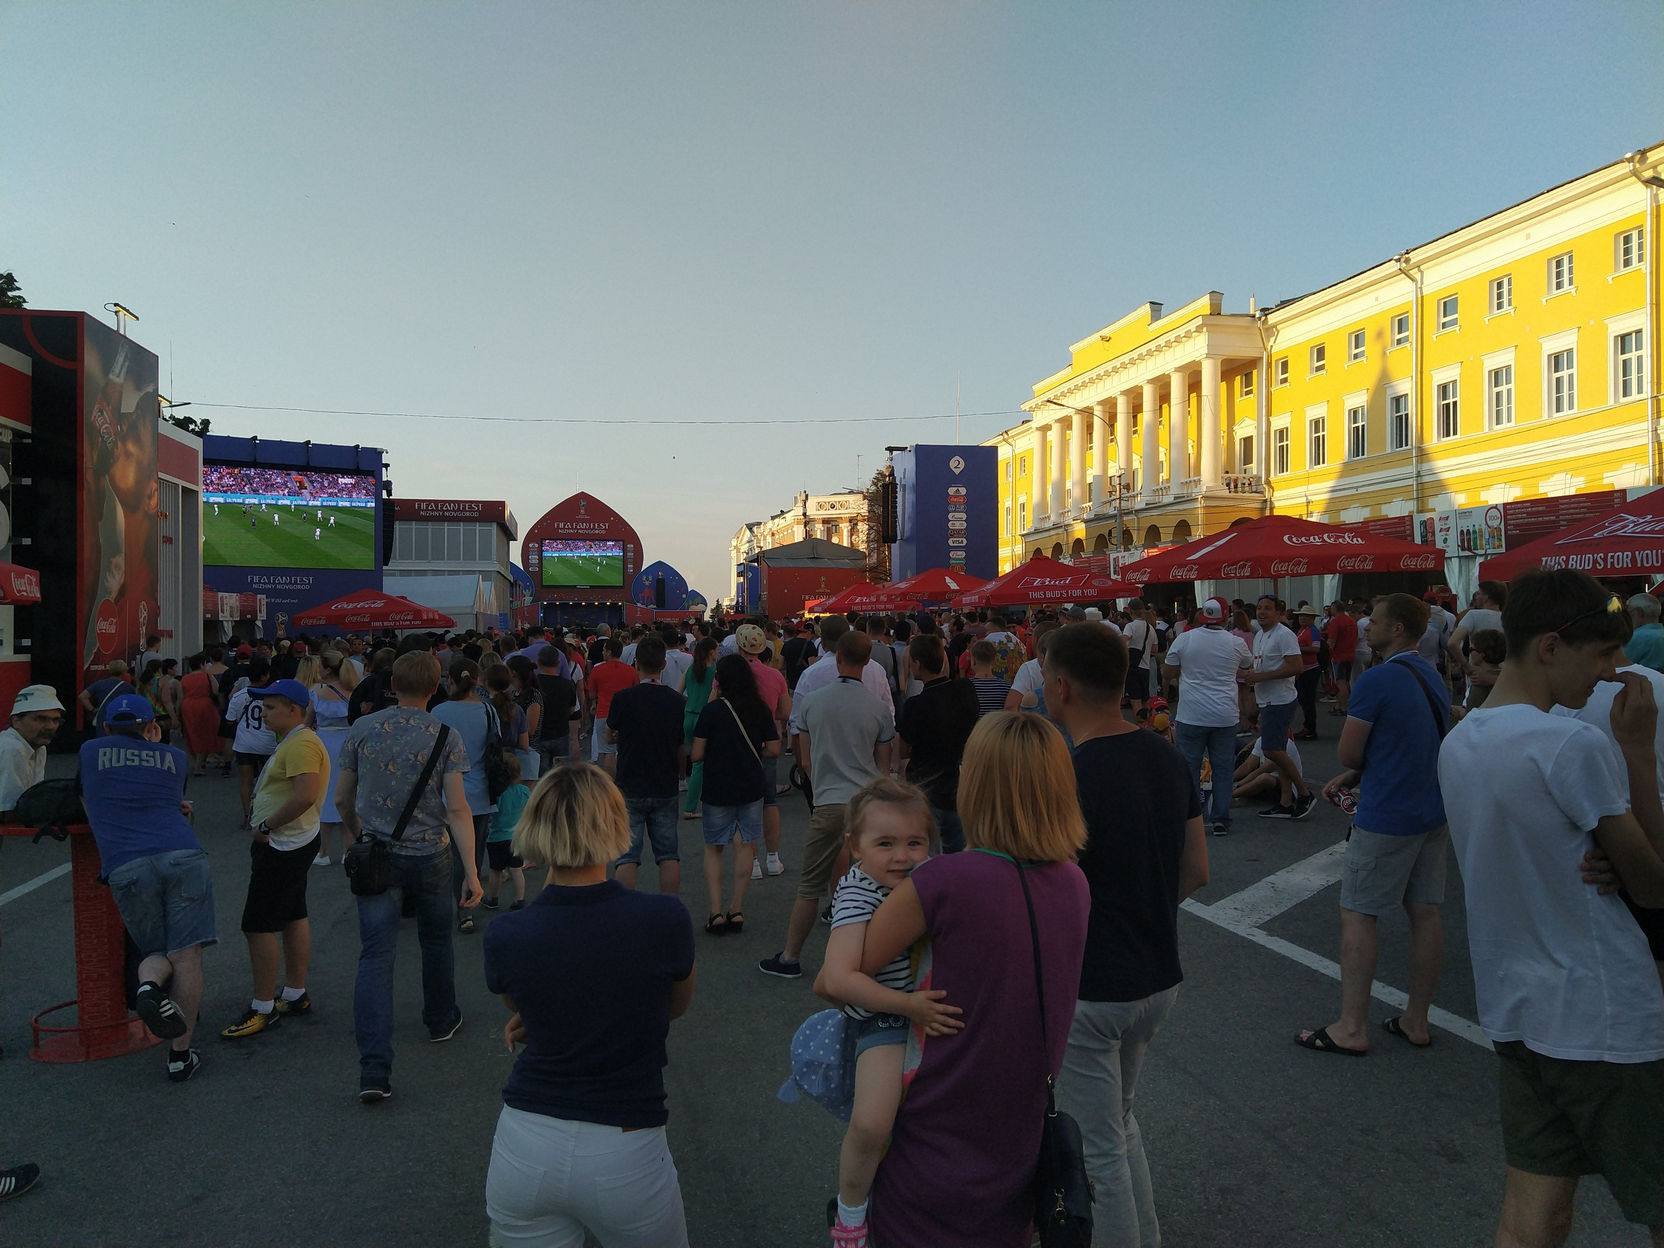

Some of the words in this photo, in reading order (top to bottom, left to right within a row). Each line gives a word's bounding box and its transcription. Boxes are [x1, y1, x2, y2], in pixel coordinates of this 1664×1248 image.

[953, 459, 961, 469] 2
[415, 502, 436, 510] FIFA
[438, 502, 458, 511] FAN
[460, 503, 483, 511] FEST
[590, 522, 609, 530] FEST
[1540, 556, 1566, 571] THIS
[1568, 553, 1604, 570] BUD'S
[1607, 551, 1632, 568] FOR
[1635, 550, 1662, 567] YOU
[247, 575, 268, 583] FIFA
[270, 576, 290, 584] FAN
[292, 576, 314, 584] FEST
[1033, 576, 1072, 586] Bud
[1028, 591, 1045, 599] THIS
[1046, 590, 1067, 598] BUD'S
[1068, 589, 1082, 597] FOR
[243, 704, 263, 730] 19
[98, 747, 177, 774] RUSSIA
